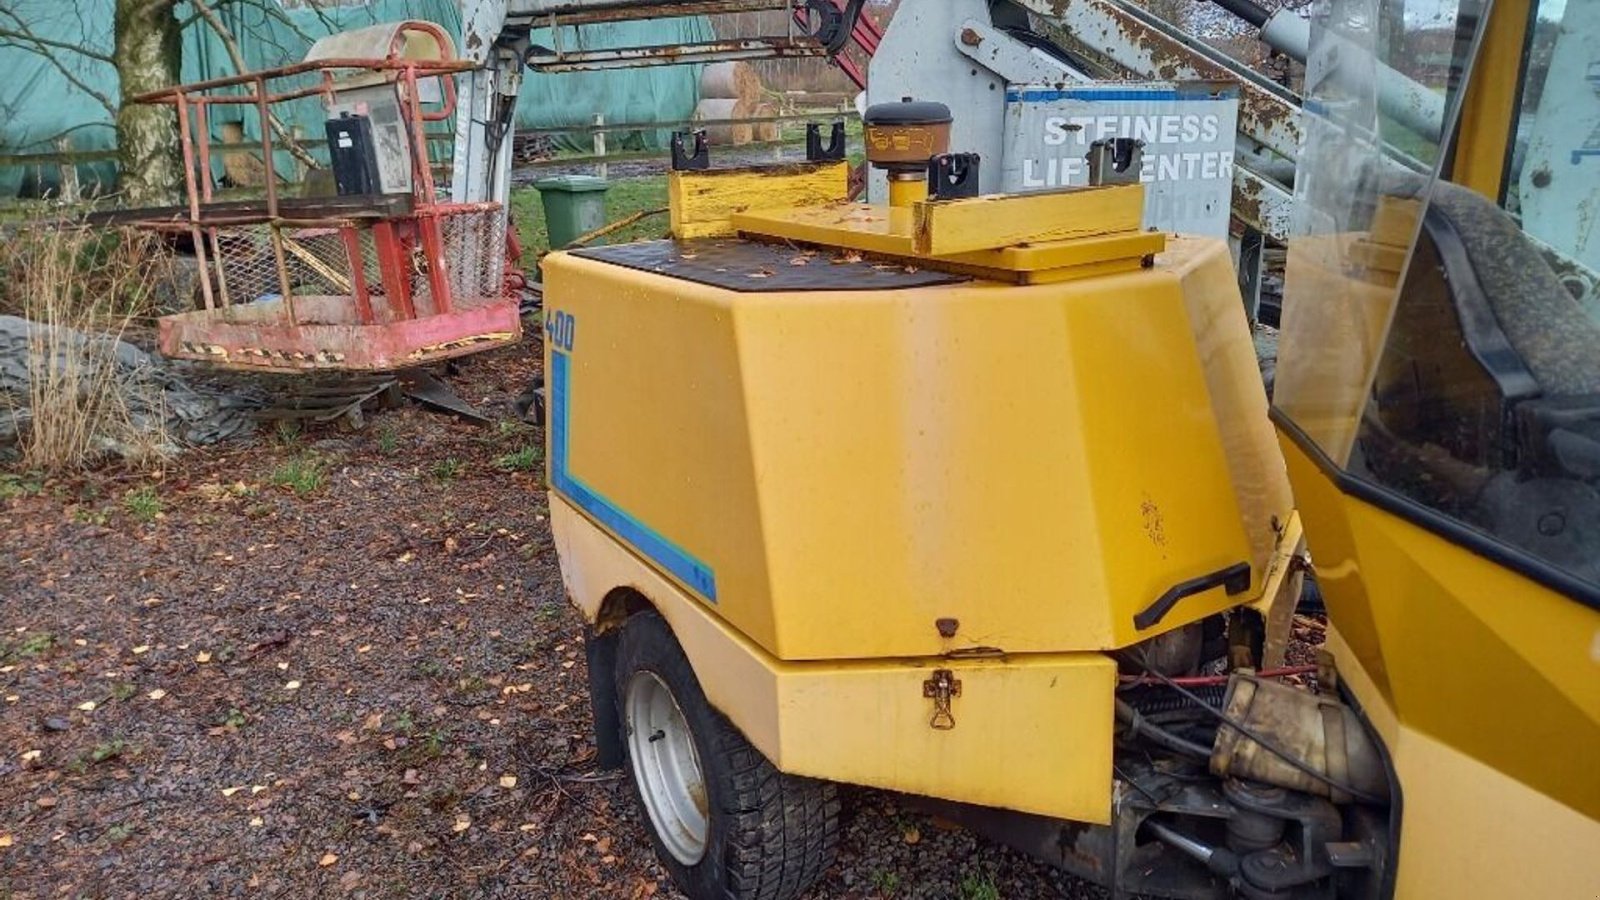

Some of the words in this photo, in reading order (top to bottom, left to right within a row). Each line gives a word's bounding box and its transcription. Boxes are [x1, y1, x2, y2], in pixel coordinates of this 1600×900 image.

[1043, 115, 1219, 146] STEINESS
[1023, 156, 1091, 187] LIF
[1138, 150, 1234, 183] ENTER
